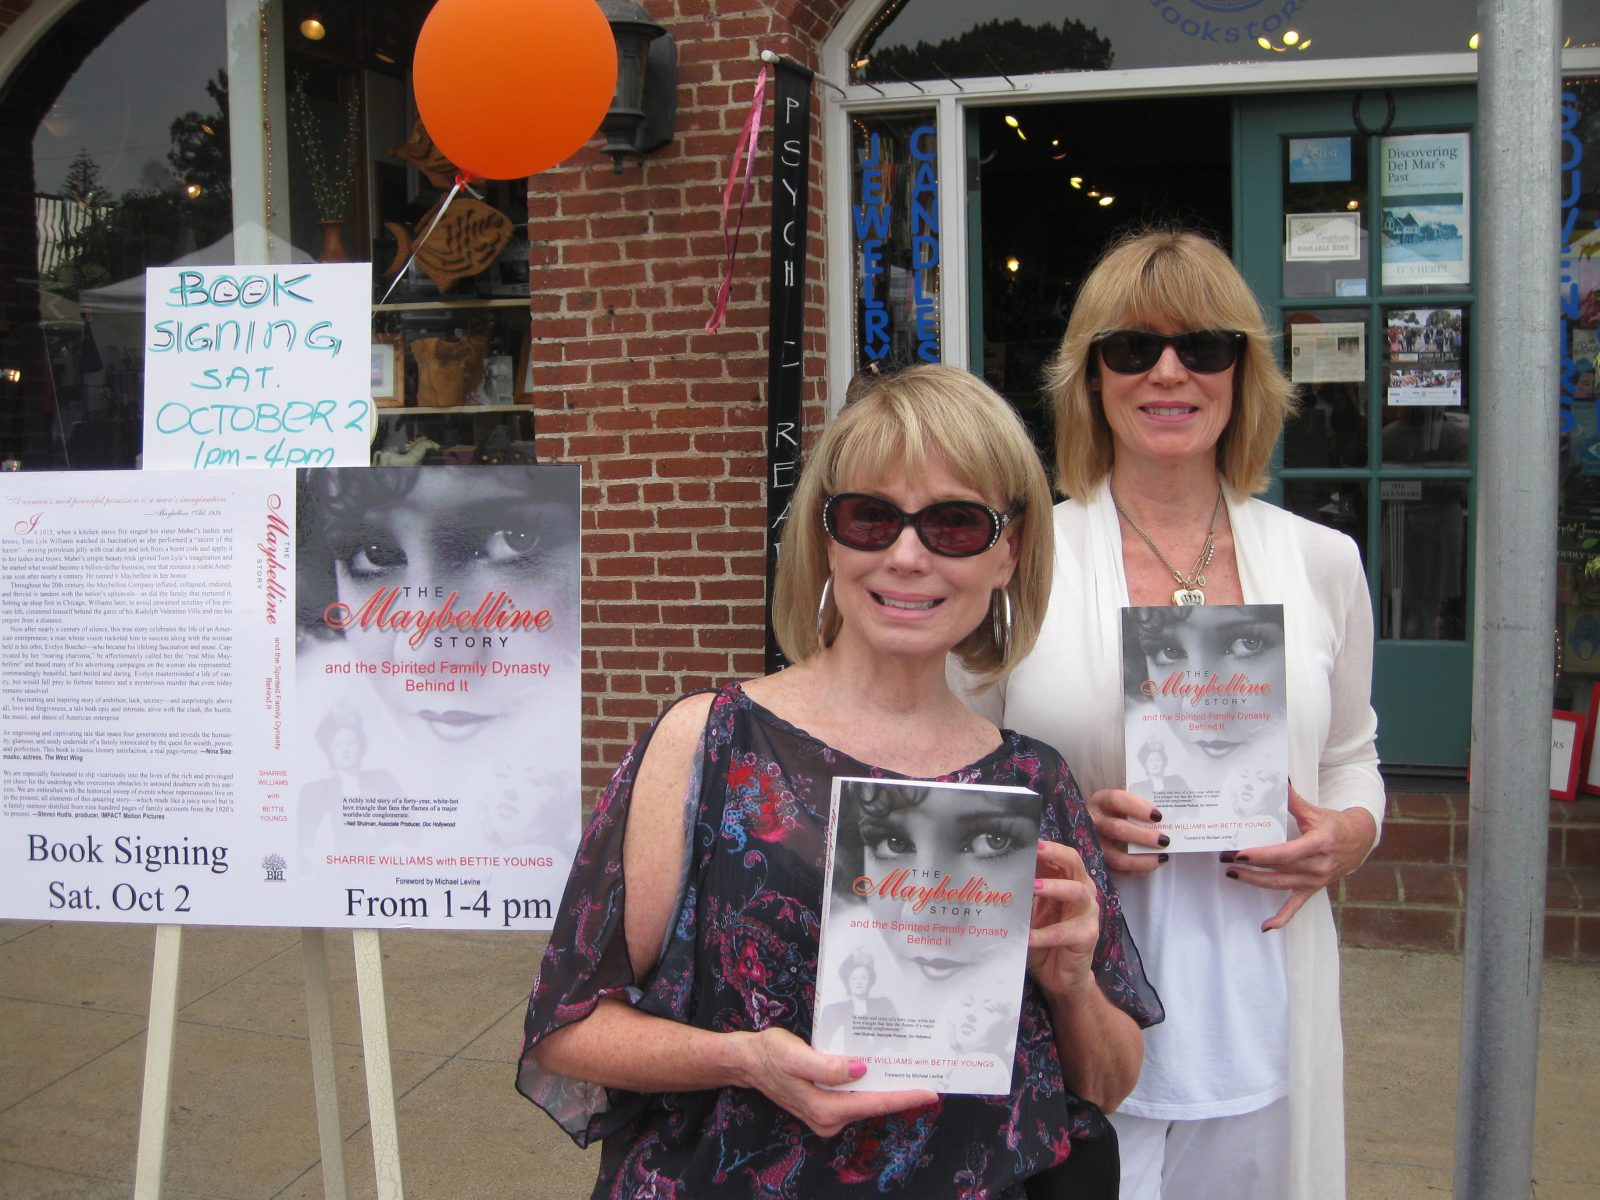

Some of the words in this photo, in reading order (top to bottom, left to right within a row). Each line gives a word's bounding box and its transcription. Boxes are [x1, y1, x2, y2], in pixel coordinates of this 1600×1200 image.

[1388, 147, 1458, 160] Discovering
[1388, 160, 1408, 171] Del
[1412, 158, 1446, 170] Mar's
[1388, 172, 1409, 183] Past
[165, 271, 314, 307] BOOK
[191, 366, 281, 392] SAT.
[156, 400, 338, 435] OCTOBER
[345, 400, 369, 432] 2
[257, 493, 290, 625] Maybelline
[403, 586, 444, 598] THE
[323, 584, 552, 648] Maybelline
[434, 636, 509, 648] STORY
[325, 661, 351, 674] and
[355, 661, 377, 674] the
[381, 661, 436, 677] Spirited
[440, 661, 487, 677] Family
[492, 662, 550, 677] Dynasty
[1186, 670, 1210, 678] THE
[405, 679, 455, 692] Behind
[459, 679, 469, 692] It
[1140, 671, 1272, 705] Maybelline
[1204, 698, 1247, 706] STORY
[1142, 713, 1157, 721] and
[1159, 713, 1173, 721] the
[1175, 712, 1206, 723] Spirited
[1208, 712, 1236, 722] Family
[1237, 711, 1271, 721] Dynasty
[1188, 723, 1218, 731] Behind
[274, 721, 282, 750] Dynasty
[27, 834, 104, 864] Book
[114, 835, 229, 874] Signing
[326, 855, 376, 865] SHARRIE
[379, 855, 433, 866] WILLIAMS
[436, 856, 457, 866] with
[460, 856, 500, 867] BETTIE
[503, 857, 553, 867] YOUNGS
[912, 868, 941, 879] THE
[395, 877, 425, 886] Foreword
[426, 877, 433, 887] by
[434, 877, 459, 886] Michael
[460, 877, 481, 886] Levine
[49, 881, 101, 910] Sat.
[112, 883, 165, 912] Oct
[174, 884, 191, 912] 2
[852, 867, 1015, 913] Maybelline
[345, 888, 429, 918] From
[443, 889, 491, 918] 1-4
[502, 897, 553, 927] pm
[929, 905, 983, 917] STORY
[850, 919, 869, 929] and
[872, 920, 888, 930] the
[890, 920, 930, 933] Spirited
[932, 923, 966, 935] Family
[968, 925, 1009, 938] Dynasty
[907, 934, 942, 945] Behind
[945, 936, 952, 946] It
[874, 1056, 913, 1065] WILLIAMS
[914, 1057, 929, 1066] with
[930, 1058, 959, 1067] BETTIE
[961, 1059, 995, 1068] YOUNGS
